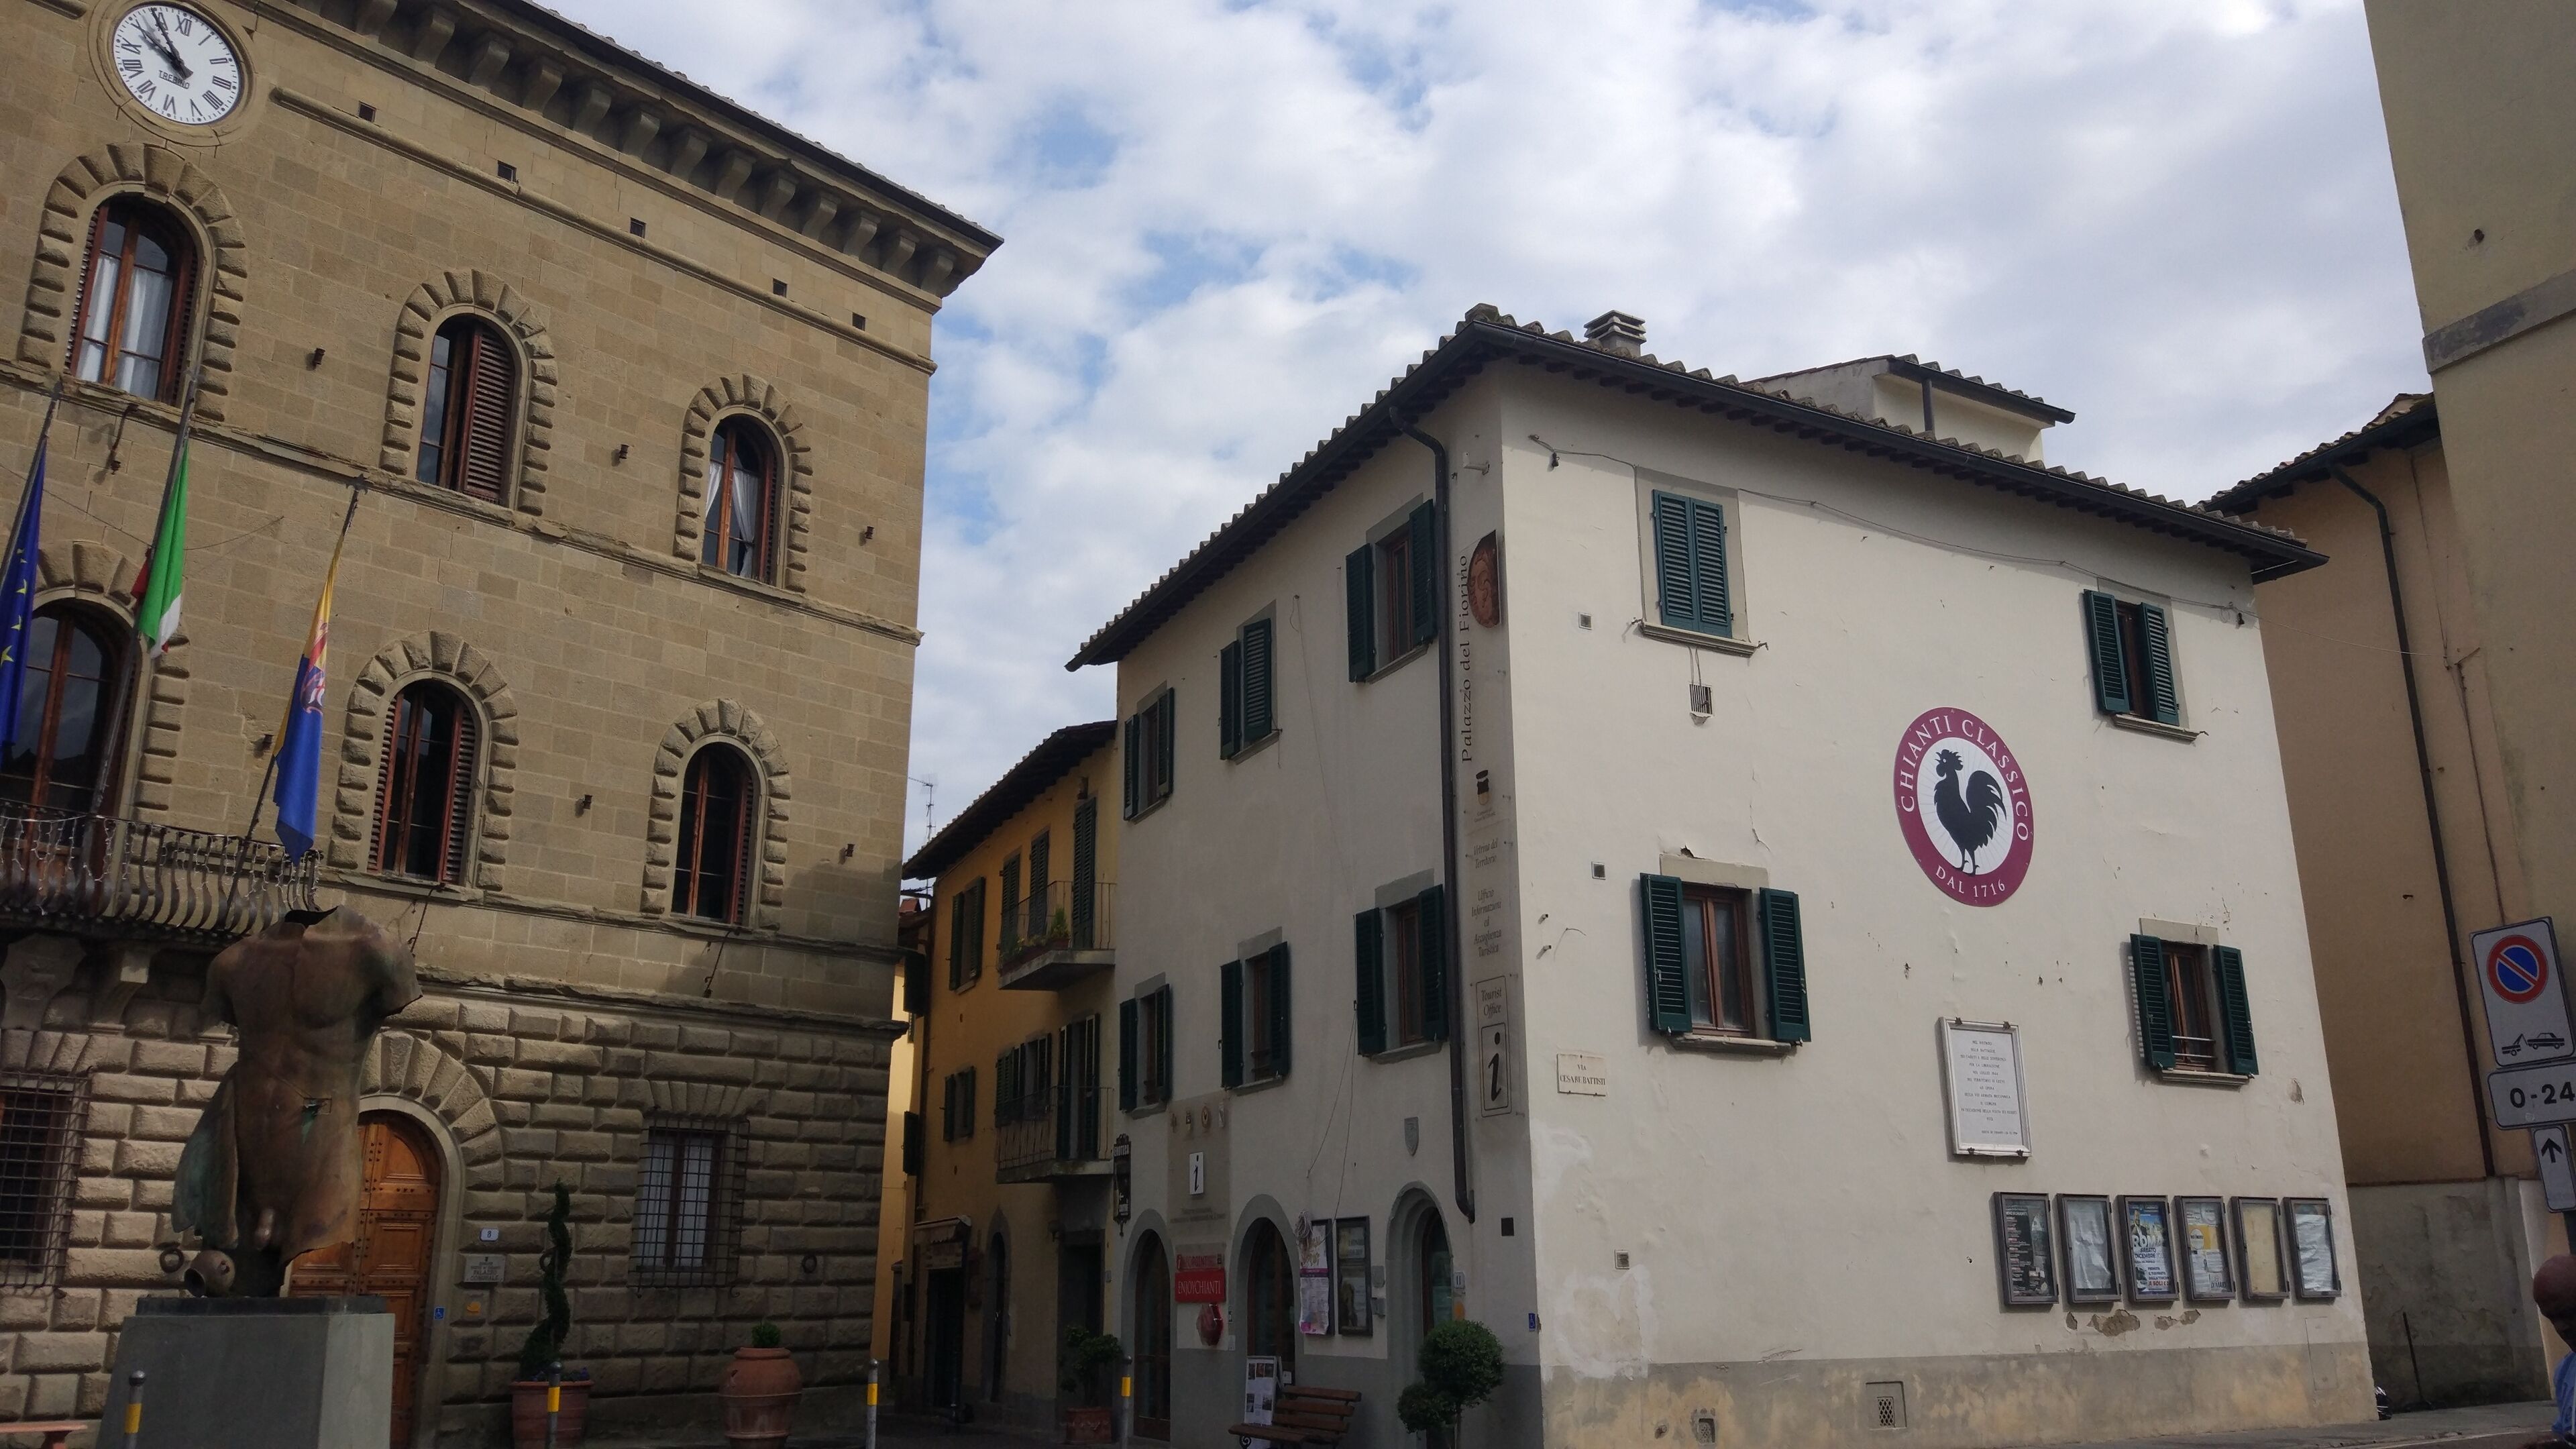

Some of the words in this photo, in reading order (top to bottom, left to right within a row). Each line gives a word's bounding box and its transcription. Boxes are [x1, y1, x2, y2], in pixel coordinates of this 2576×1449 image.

[1458, 554, 1470, 633] Fiorino
[1460, 641, 1470, 671] del
[1462, 678, 1472, 762] Palazzo
[1900, 715, 1952, 812] CHIANTI
[1962, 719, 2029, 841] CLASSICO
[1935, 865, 1965, 894] DAL
[1973, 879, 2005, 898] 1716
[1478, 889, 1494, 903] Ufficio
[1481, 987, 1502, 1002] Tourist
[1483, 1004, 1501, 1019] Office
[1560, 1075, 1581, 1083] CESARE
[1582, 1076, 1605, 1085] BATTISTI
[2132, 1234, 2164, 1248] ROMA
